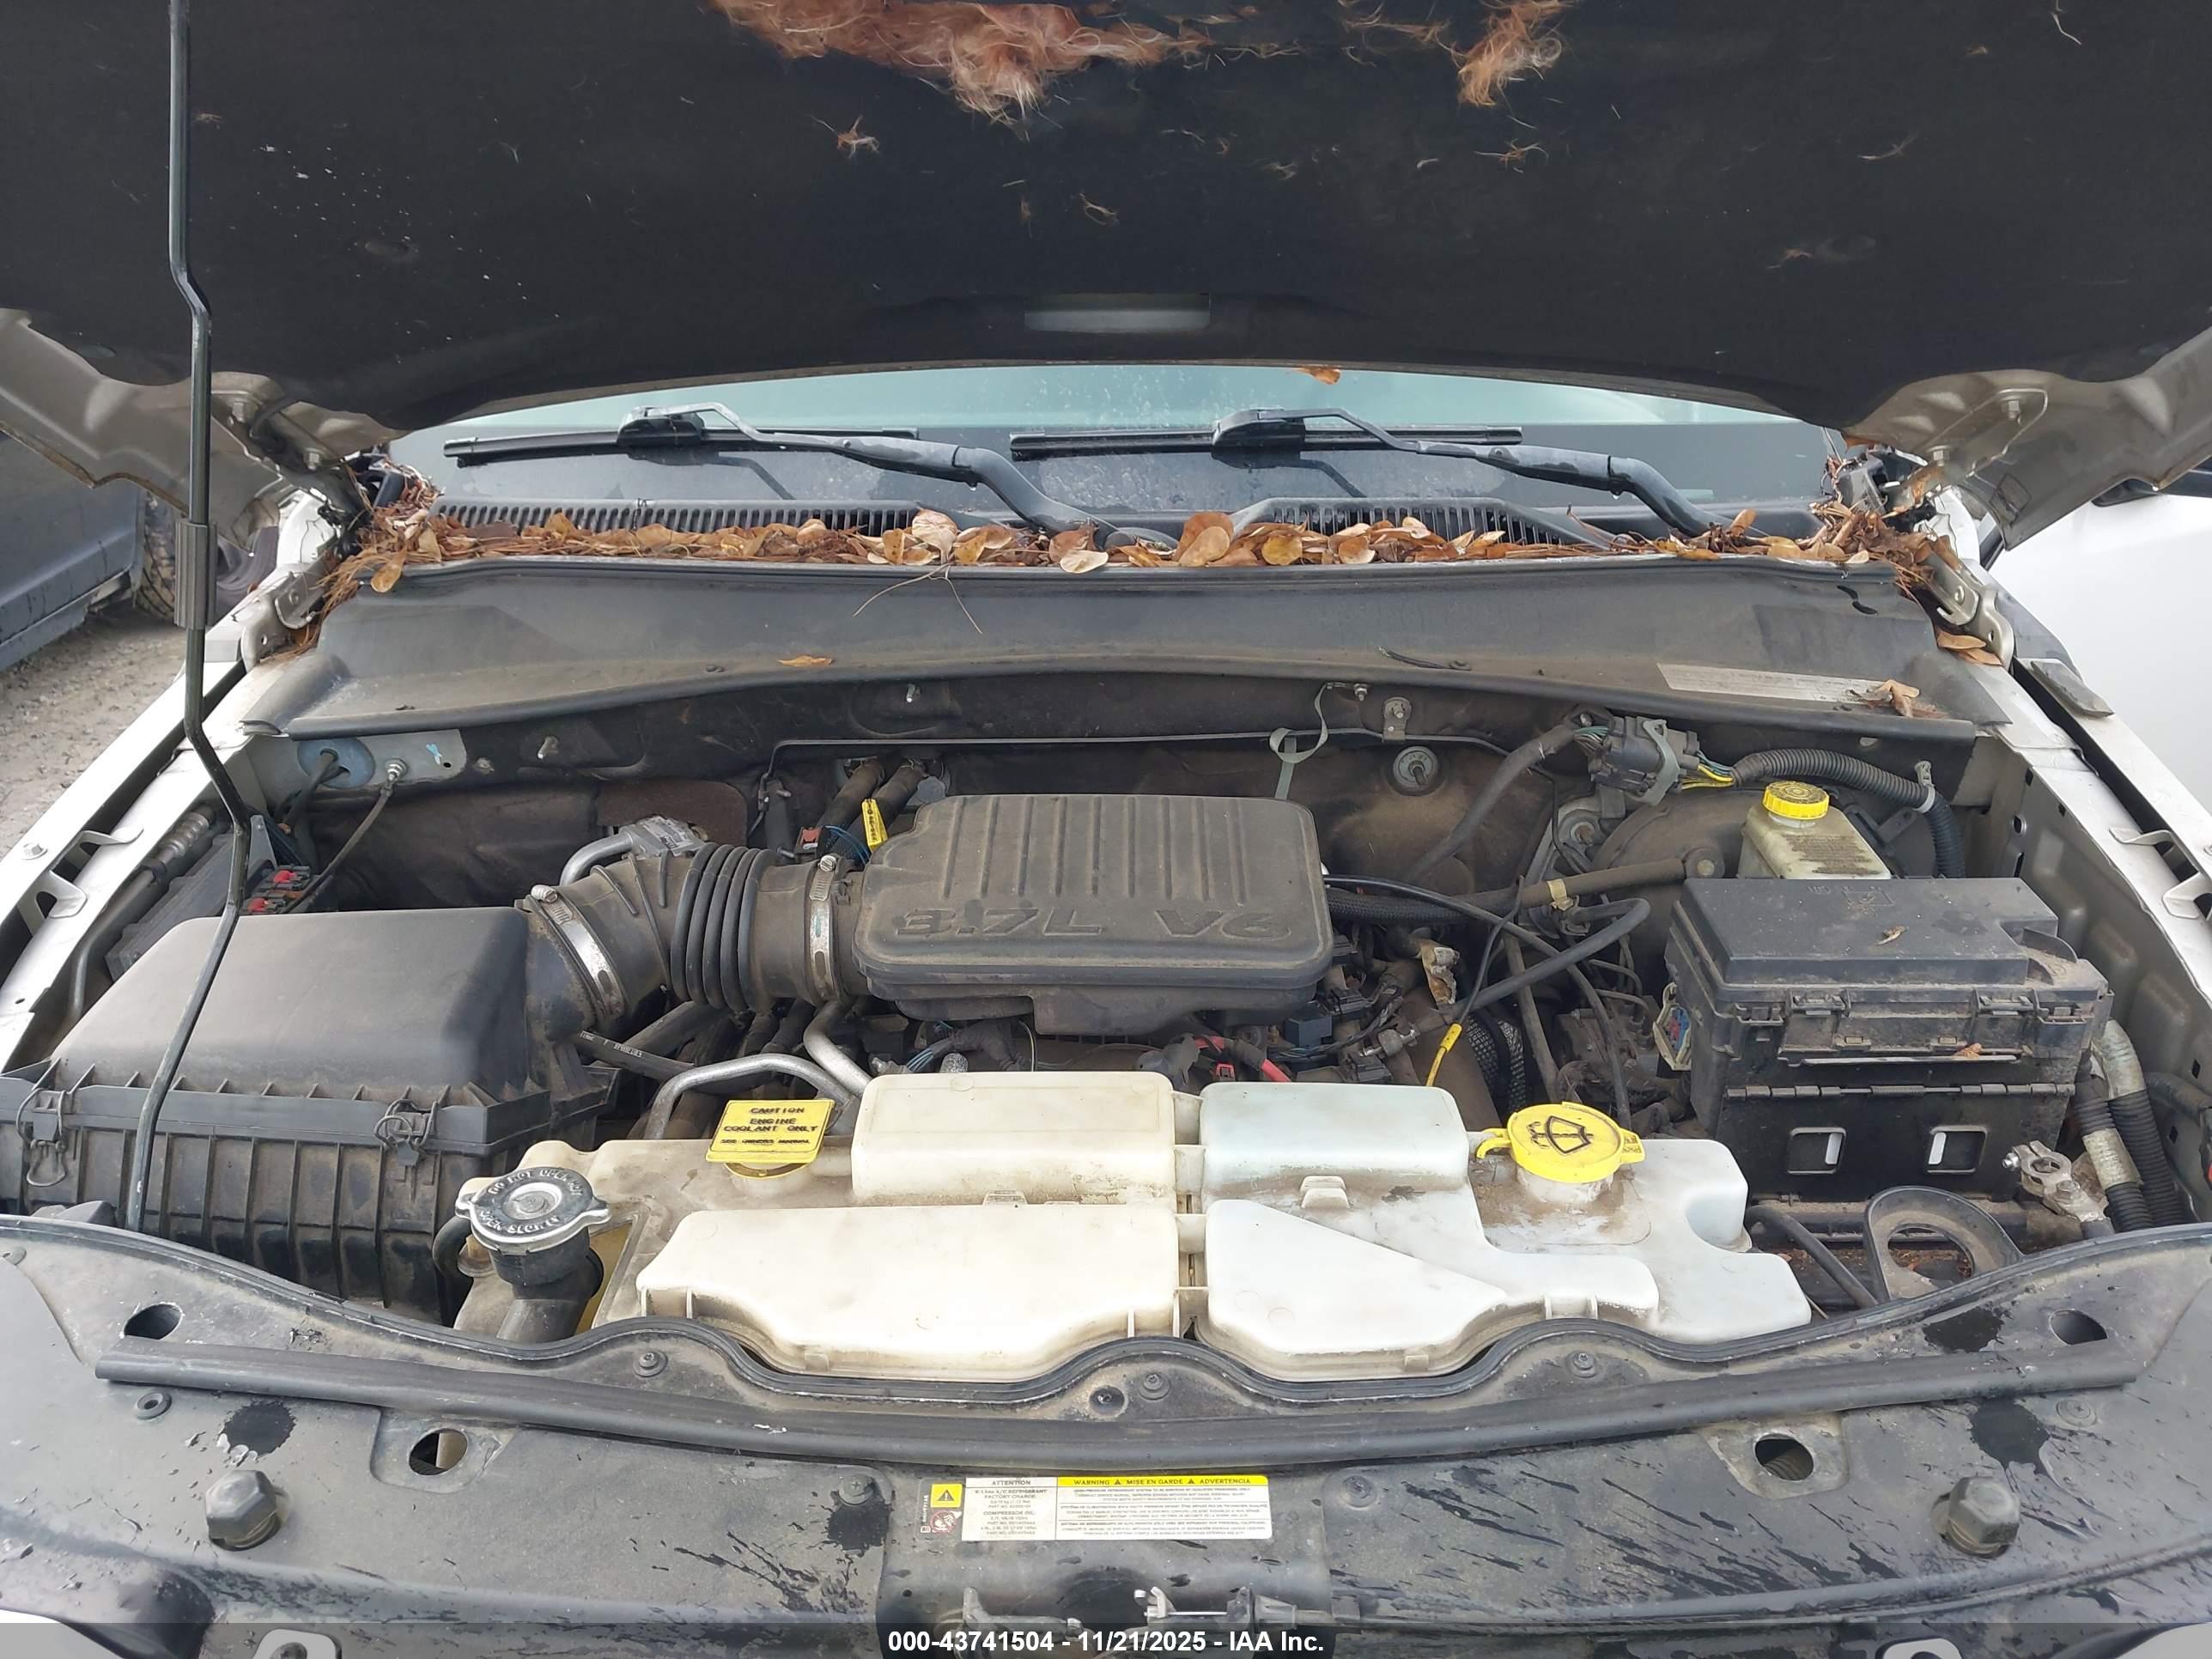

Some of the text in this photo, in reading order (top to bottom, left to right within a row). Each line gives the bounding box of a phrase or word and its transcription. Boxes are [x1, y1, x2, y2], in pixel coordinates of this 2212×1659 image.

[895, 908, 1291, 939] 3.7L V6
[488, 1182, 505, 1194] DO
[507, 1170, 532, 1183] NOT
[540, 1169, 569, 1182] OPEN
[507, 1215, 561, 1234] SLOWLY
